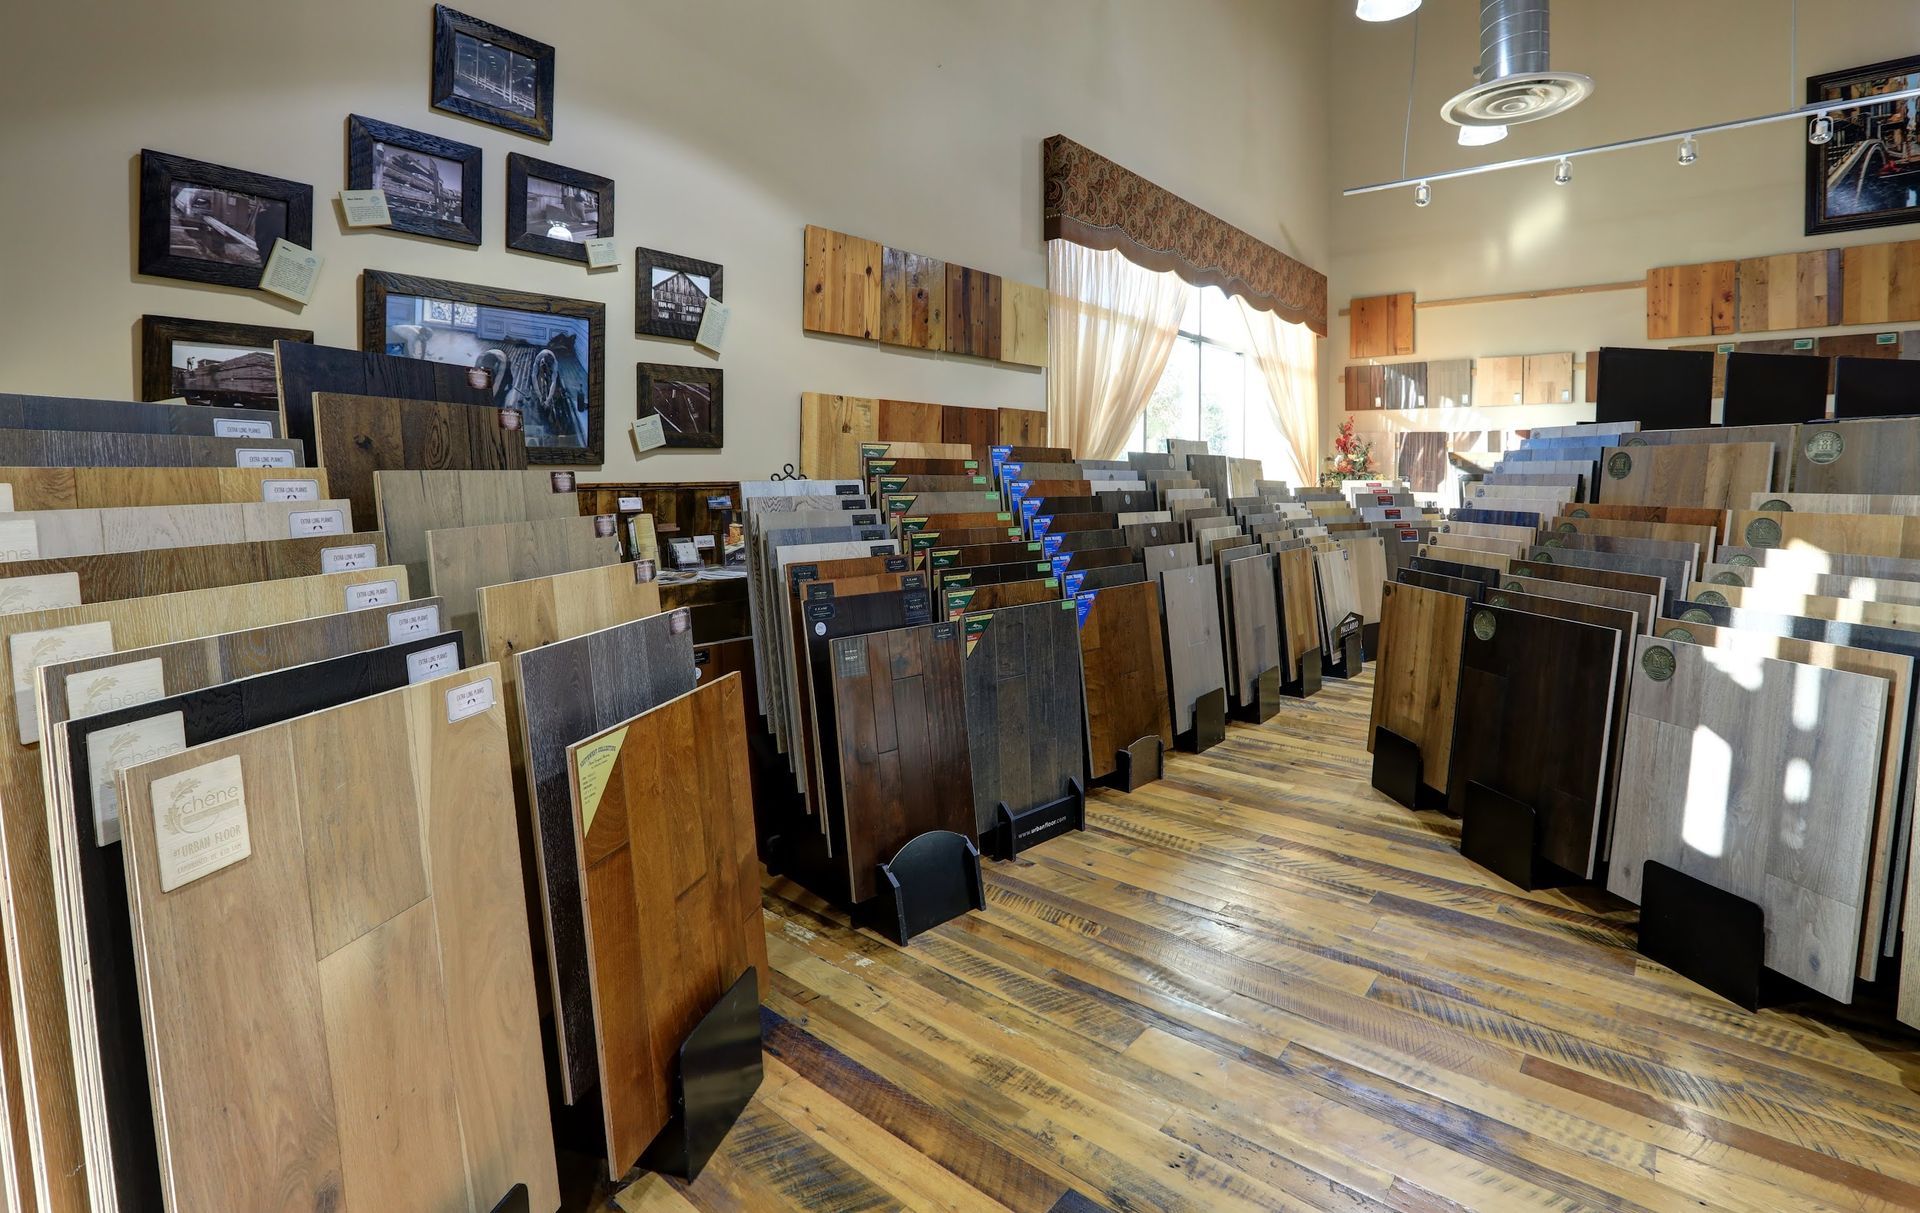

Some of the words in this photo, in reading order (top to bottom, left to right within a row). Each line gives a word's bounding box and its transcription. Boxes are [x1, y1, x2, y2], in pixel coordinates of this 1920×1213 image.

[181, 786, 239, 814] chêne
[182, 836, 210, 857] URBAN
[214, 824, 241, 844] FLOOR
[1018, 815, 1066, 839] www.urbanfloor.com
